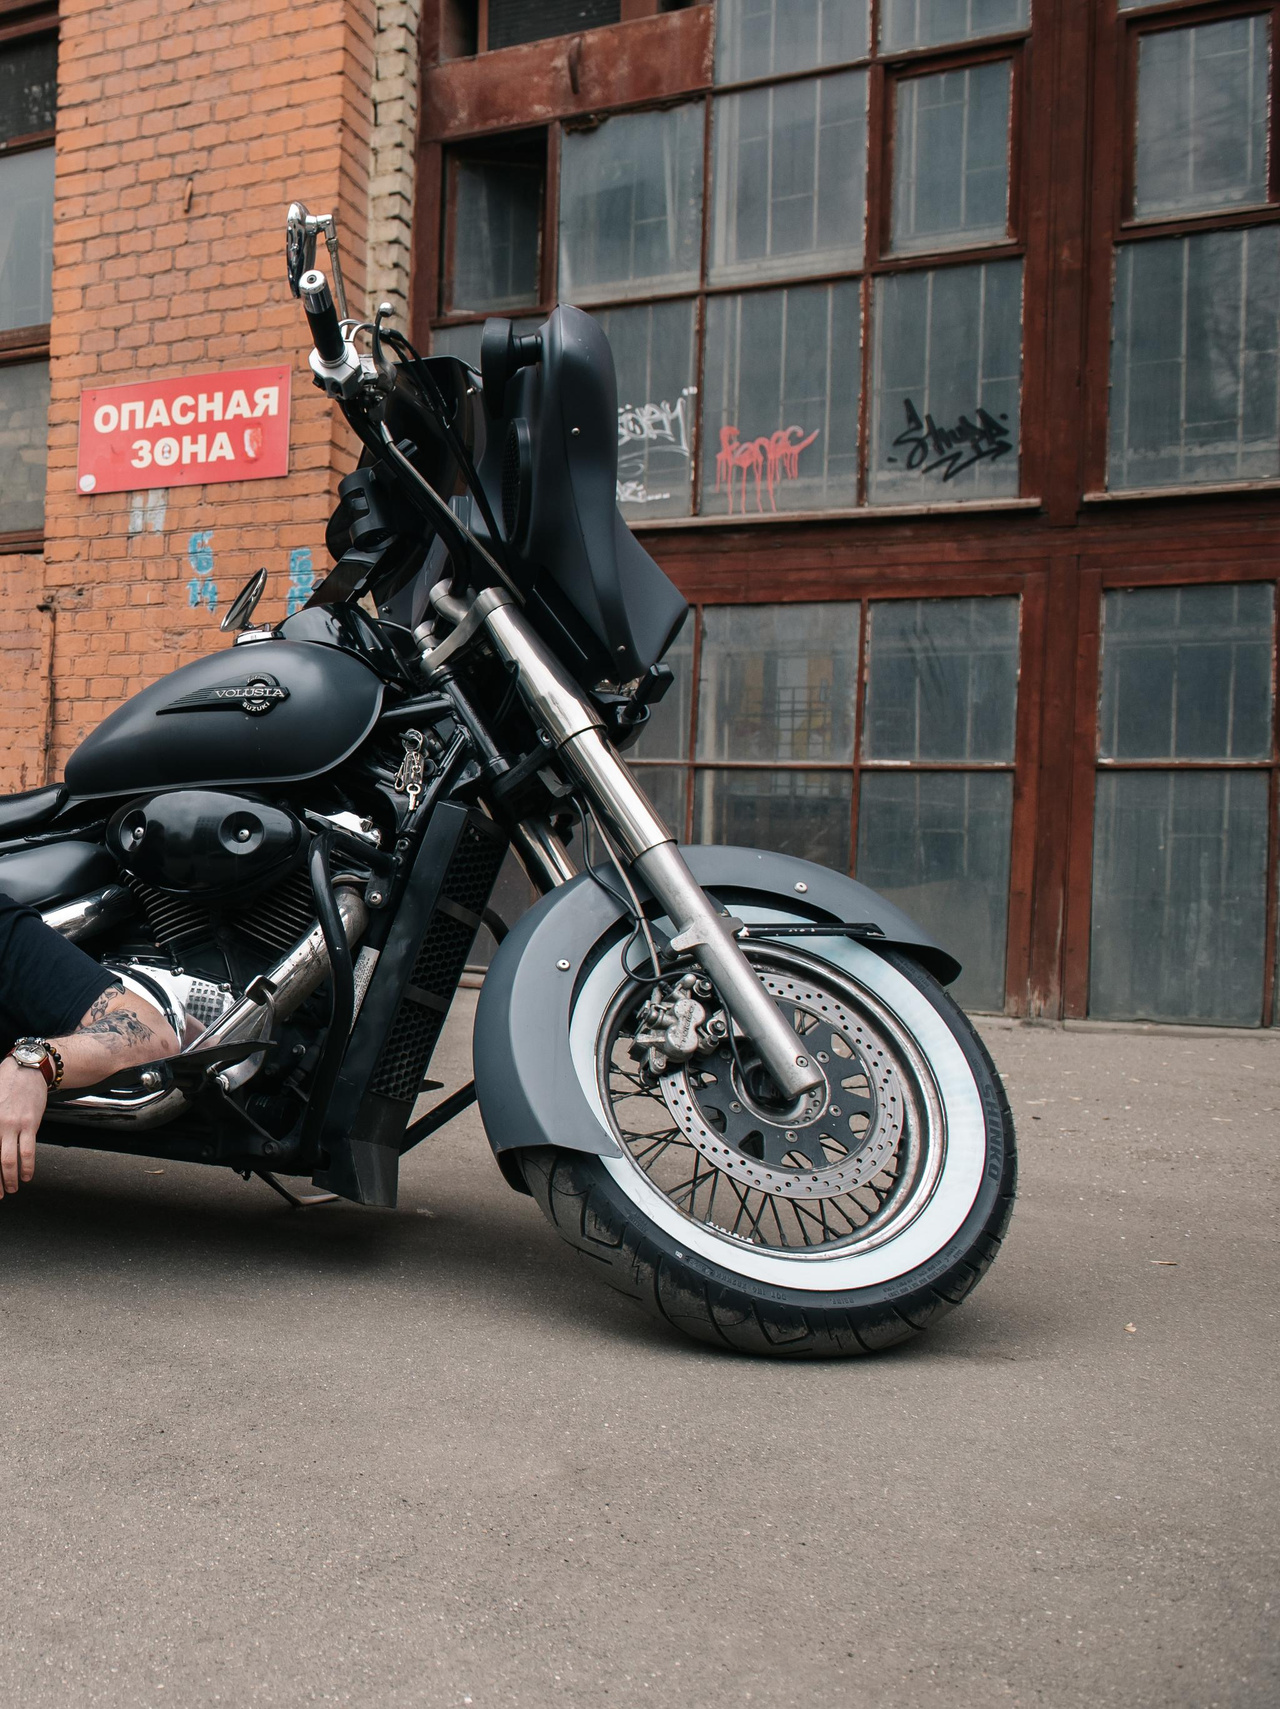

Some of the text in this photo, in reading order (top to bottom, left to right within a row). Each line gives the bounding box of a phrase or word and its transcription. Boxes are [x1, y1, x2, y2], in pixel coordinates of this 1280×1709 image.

[93, 386, 280, 434] ОПАСНАЯ
[130, 431, 236, 469] ЗОНА
[214, 688, 286, 698] VOLUSIA
[242, 702, 270, 711] SUZUKI
[981, 1084, 1003, 1181] SHINKO
